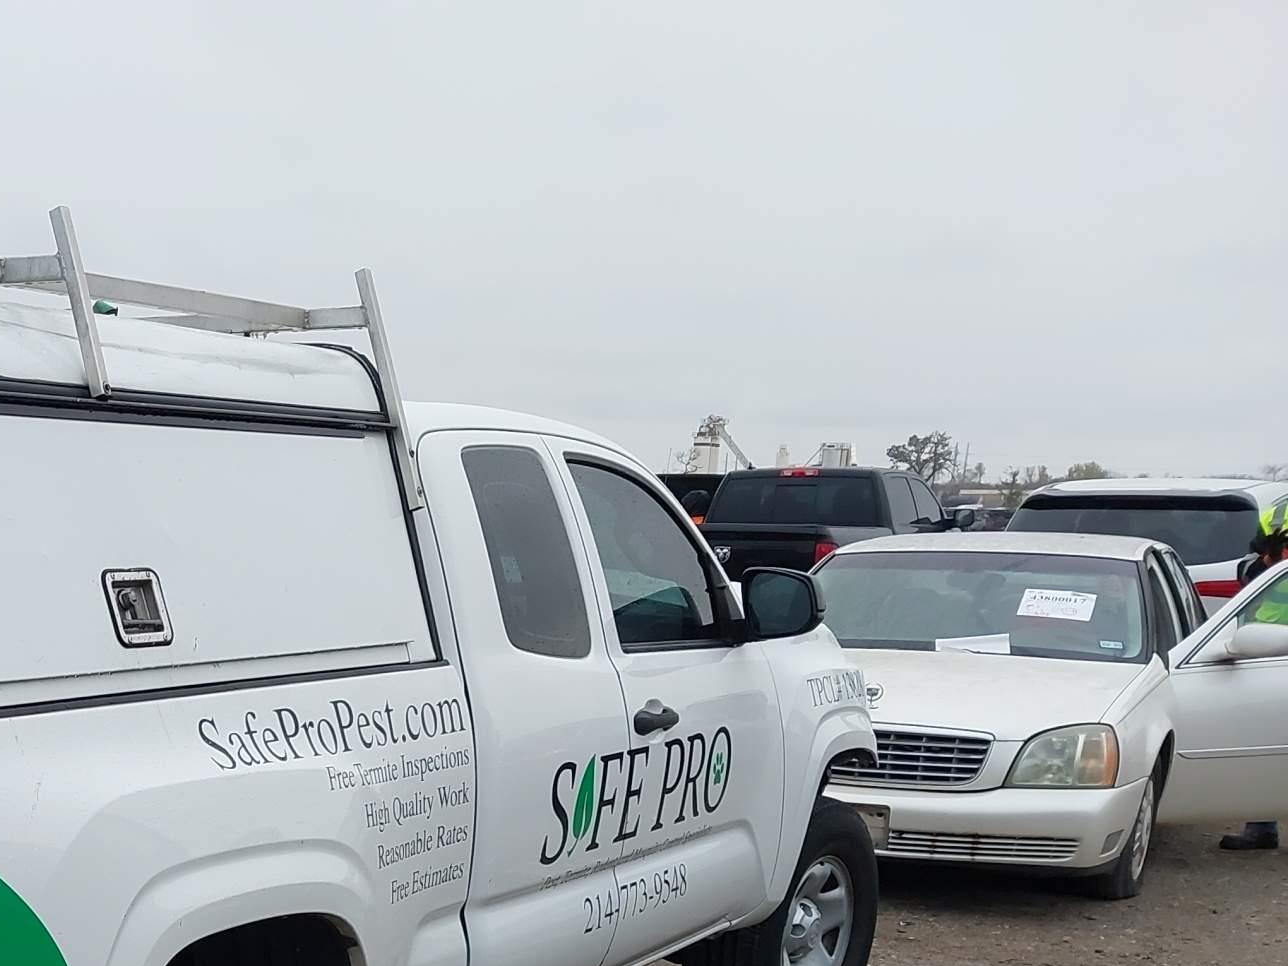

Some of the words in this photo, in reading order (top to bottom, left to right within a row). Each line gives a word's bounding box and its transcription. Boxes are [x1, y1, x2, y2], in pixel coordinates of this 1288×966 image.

[198, 697, 467, 770] SafeProPest.com
[326, 765, 356, 791] Free
[355, 757, 399, 788] Termite
[401, 746, 470, 782] Inspections
[650, 726, 732, 834] PRO
[364, 802, 391, 833] High
[393, 792, 434, 826] Quality
[437, 781, 470, 808] Work
[377, 832, 433, 869] Reasonable
[436, 822, 468, 850] Rates
[390, 879, 410, 904] Free
[412, 862, 465, 896] Estimates
[583, 862, 688, 935] 214-773-9548
